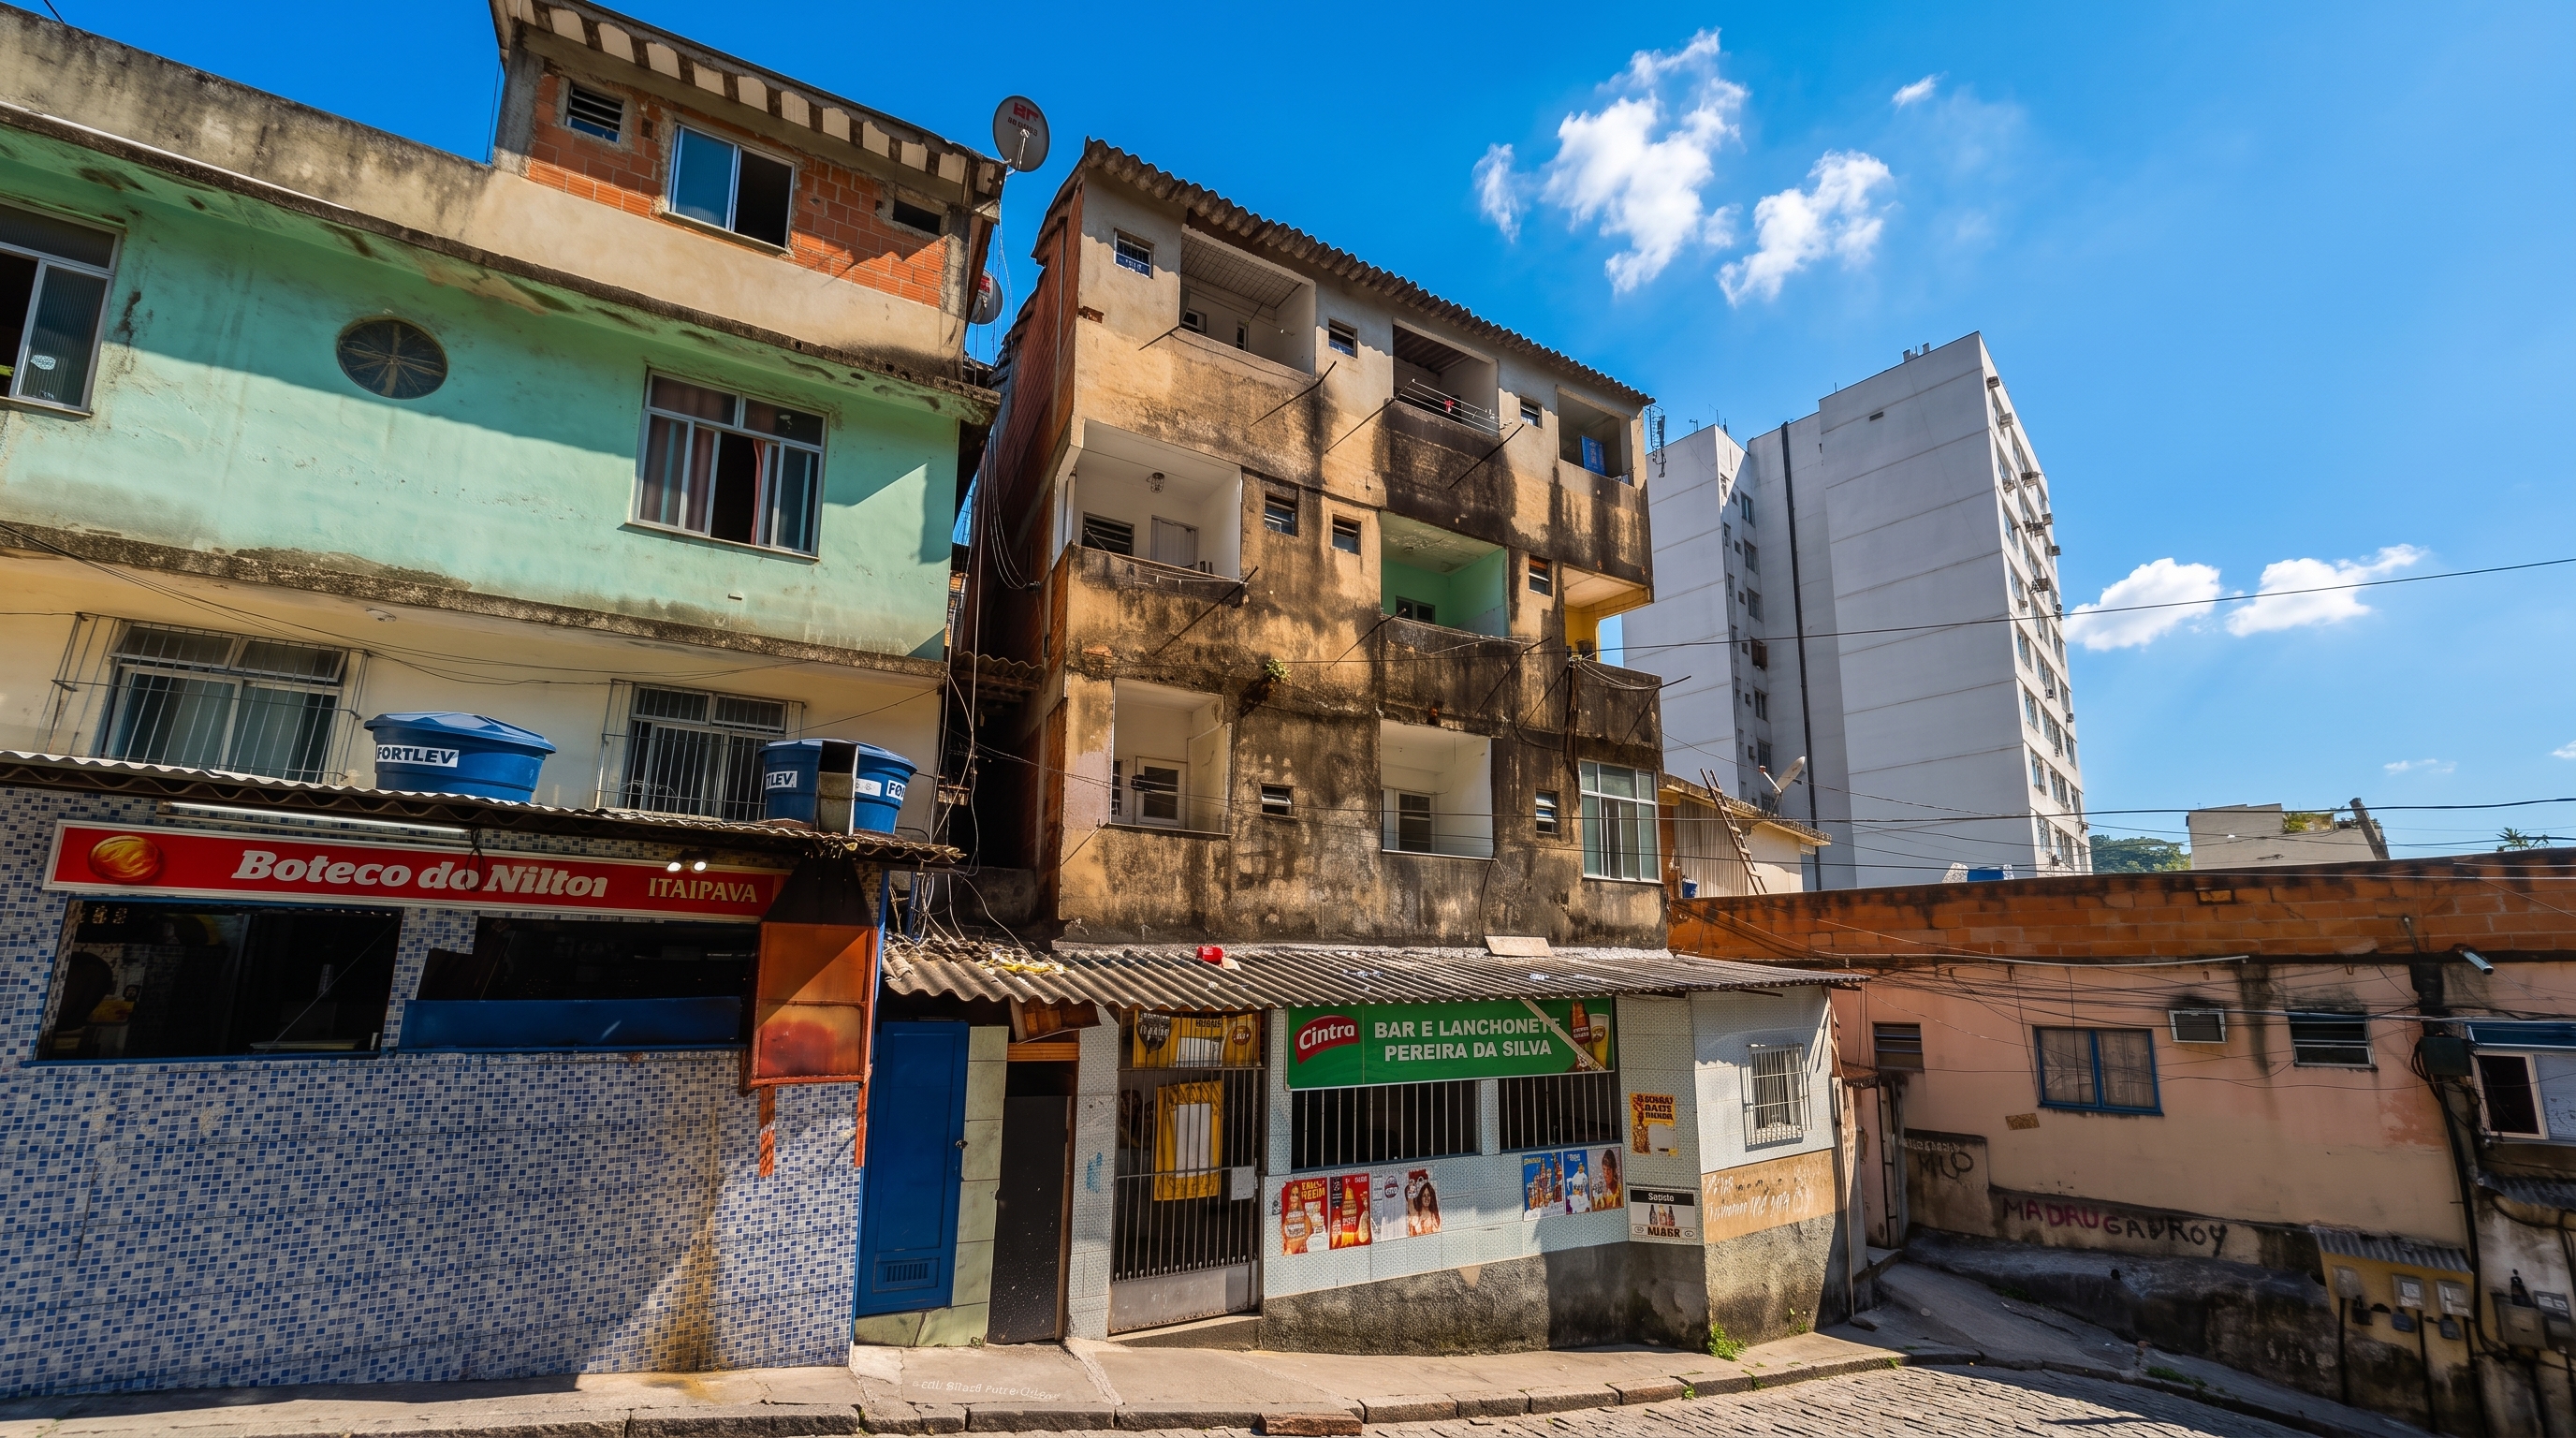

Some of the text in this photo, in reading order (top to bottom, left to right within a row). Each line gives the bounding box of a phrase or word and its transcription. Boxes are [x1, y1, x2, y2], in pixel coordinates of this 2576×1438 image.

[377, 746, 456, 764] FORTLEV
[230, 849, 412, 887] Boteco
[417, 860, 479, 890] do
[648, 876, 758, 903] ITAIPAVA
[1299, 1023, 1355, 1050] Cintra
[1374, 1021, 1416, 1039] BAR
[1421, 1020, 1433, 1037] E
[1384, 1039, 1552, 1062] PEREIRA DA SILVA
